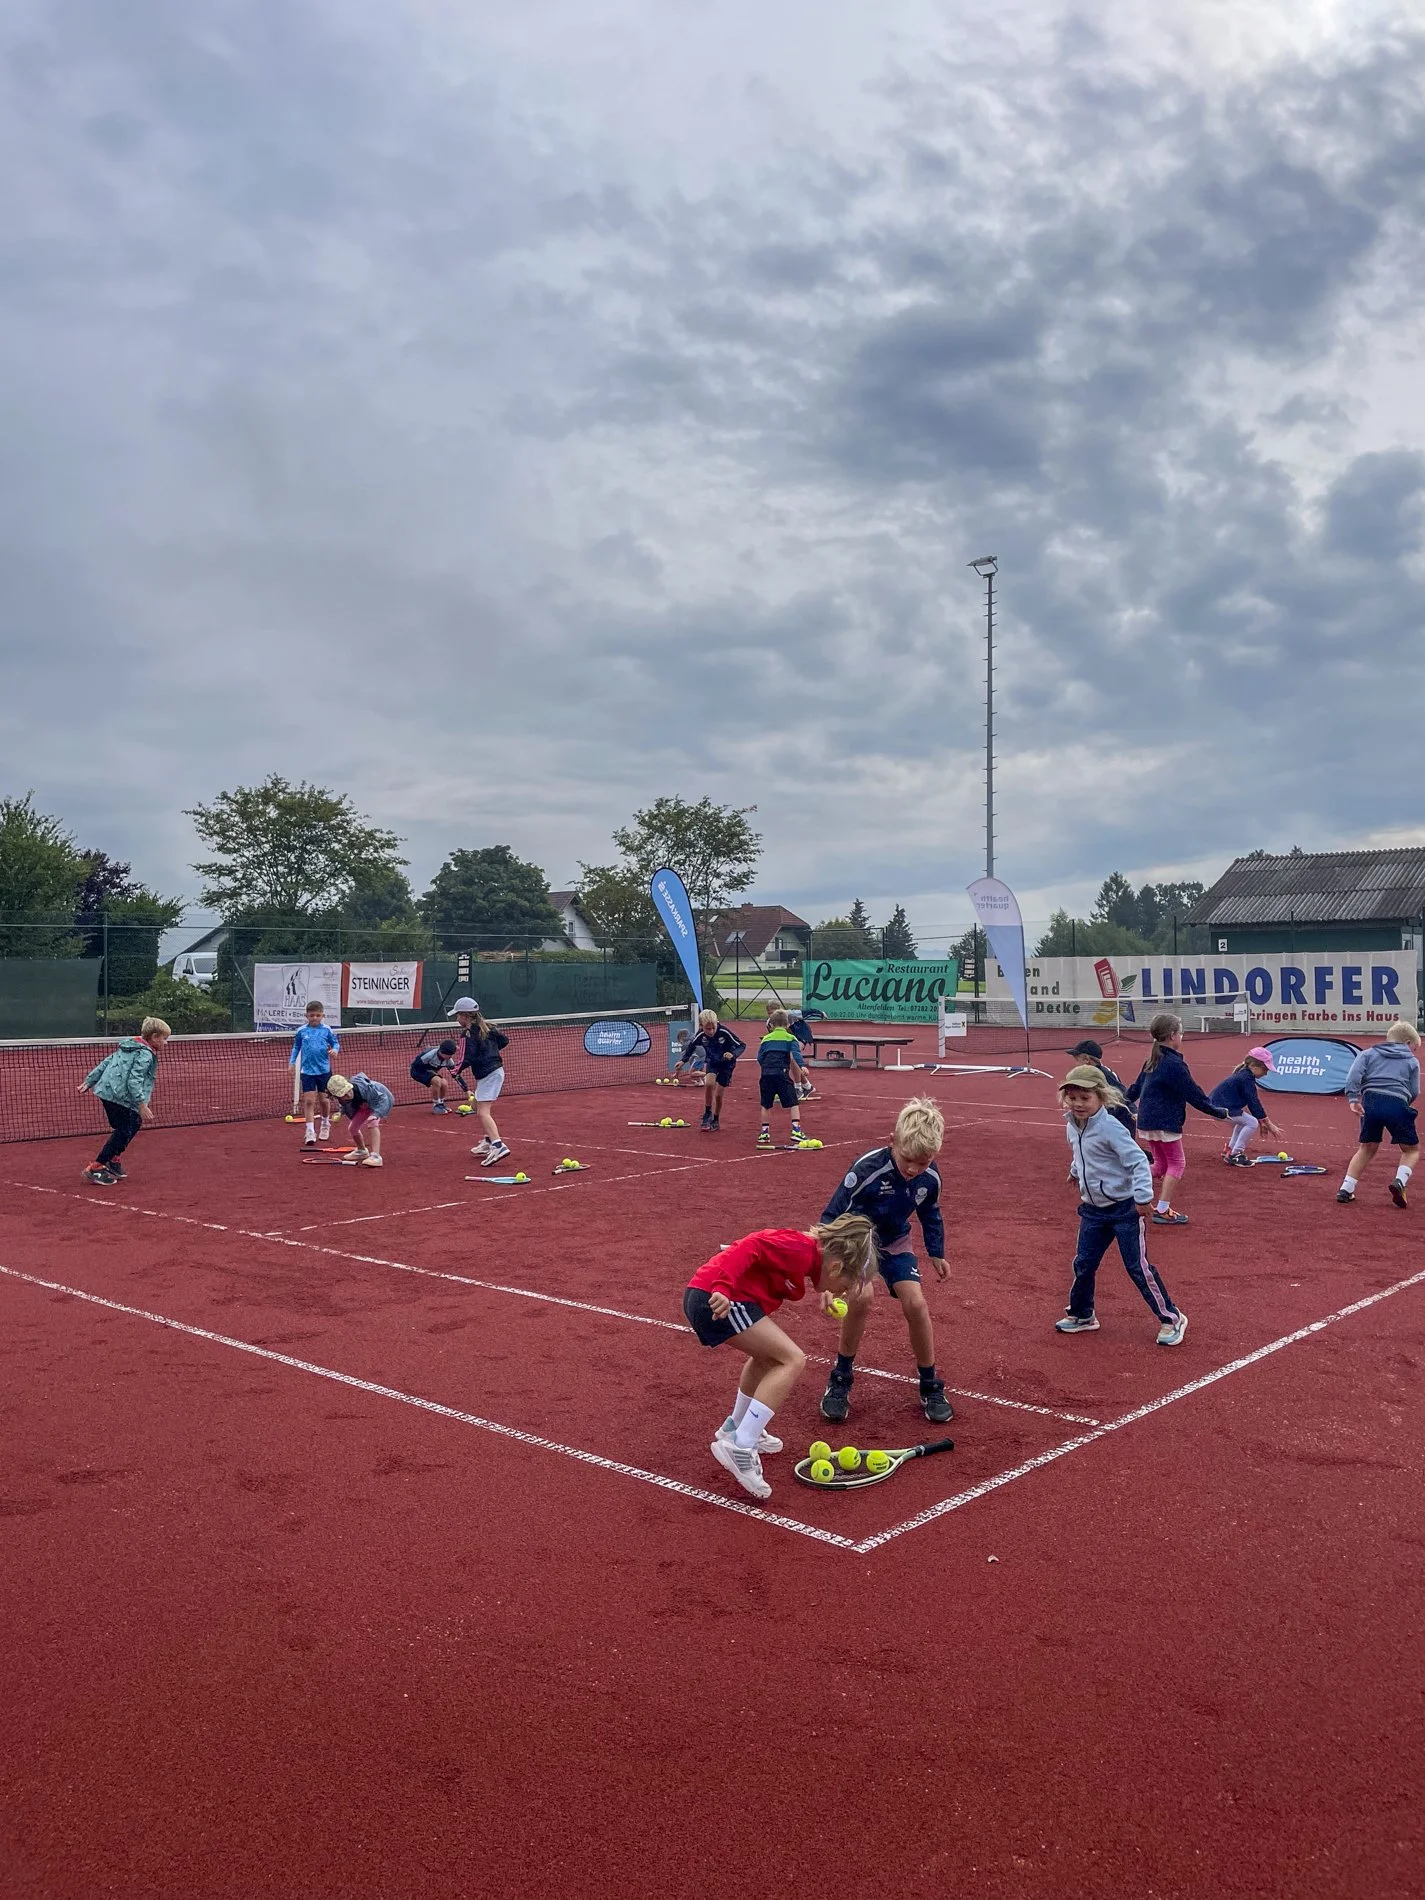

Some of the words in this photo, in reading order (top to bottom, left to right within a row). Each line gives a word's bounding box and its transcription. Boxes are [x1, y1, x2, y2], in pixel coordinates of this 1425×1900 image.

[1219, 941, 1227, 950] 2
[887, 963, 948, 974] Restaurant
[351, 976, 410, 990] STEININGER
[1141, 966, 1401, 1006] LINDORFER
[1035, 1001, 1081, 1014] Decke
[1301, 1009, 1338, 1021] Farbe
[1342, 1009, 1362, 1021] ins
[1366, 1010, 1399, 1022] Haus
[1278, 1055, 1320, 1066] health
[1276, 1065, 1326, 1076] quarter
